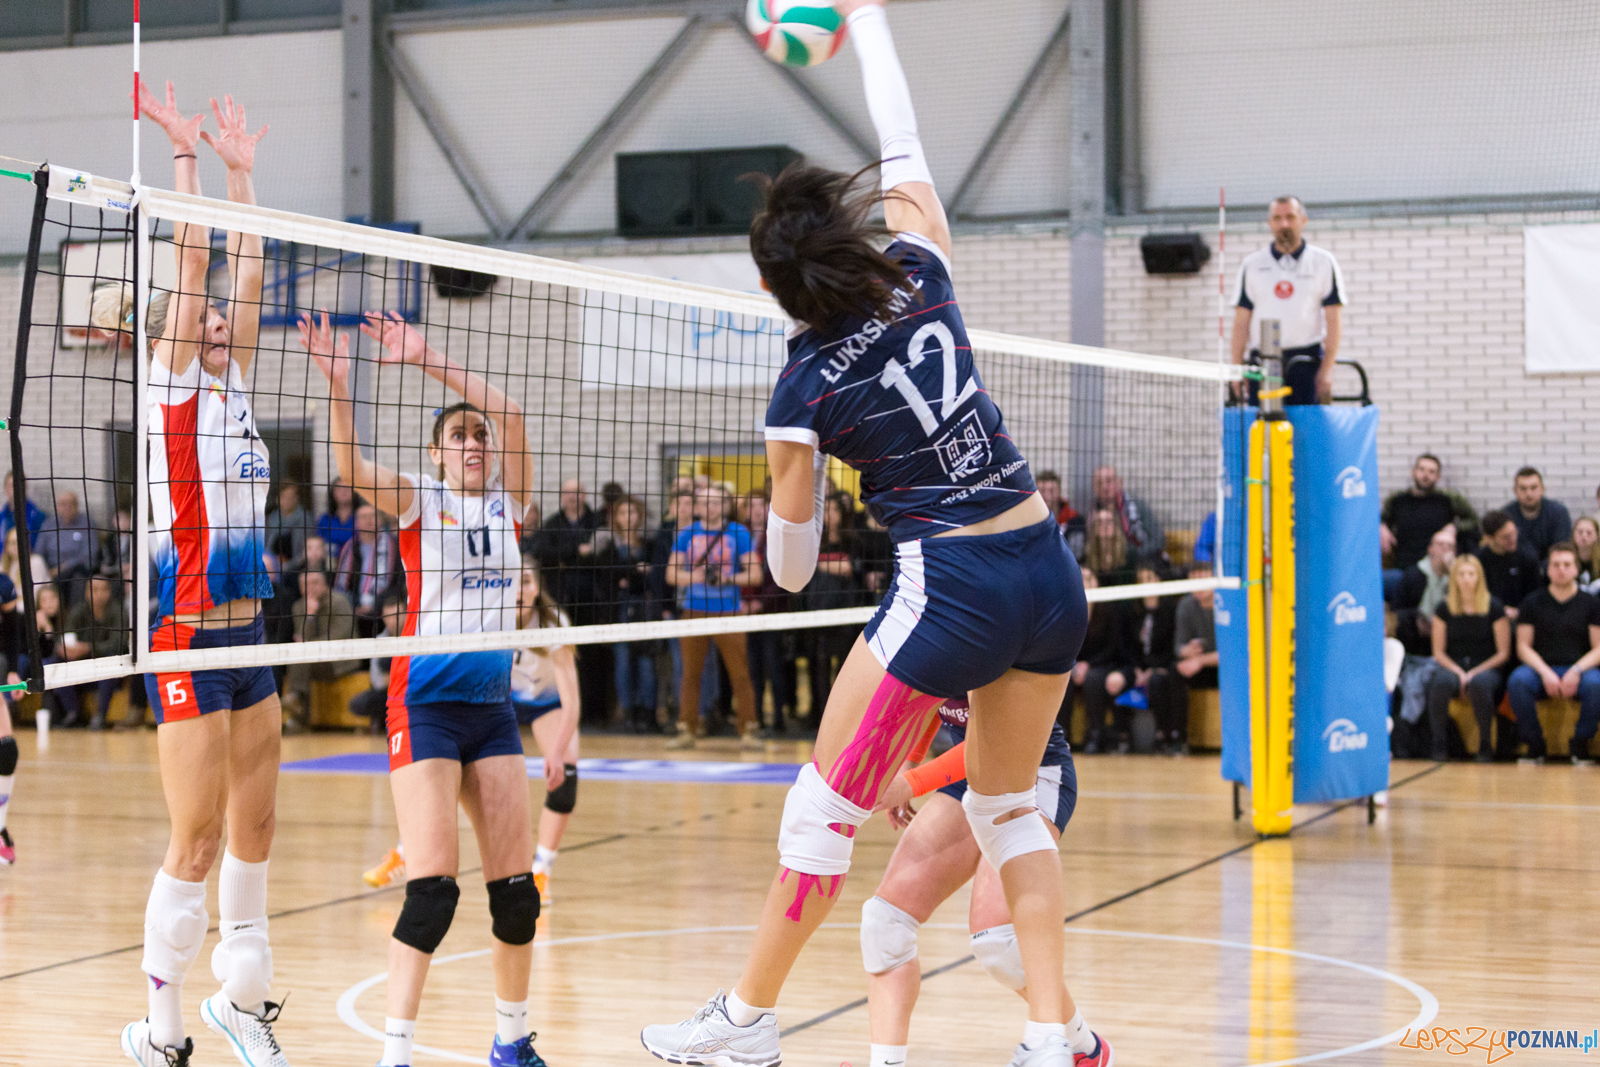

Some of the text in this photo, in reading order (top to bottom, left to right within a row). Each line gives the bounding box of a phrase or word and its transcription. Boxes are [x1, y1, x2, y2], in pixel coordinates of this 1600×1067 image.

[879, 320, 978, 437] 12
[968, 473, 1001, 495] swoją
[461, 576, 513, 590] Enea
[165, 679, 187, 706] 15
[391, 731, 403, 756] 17
